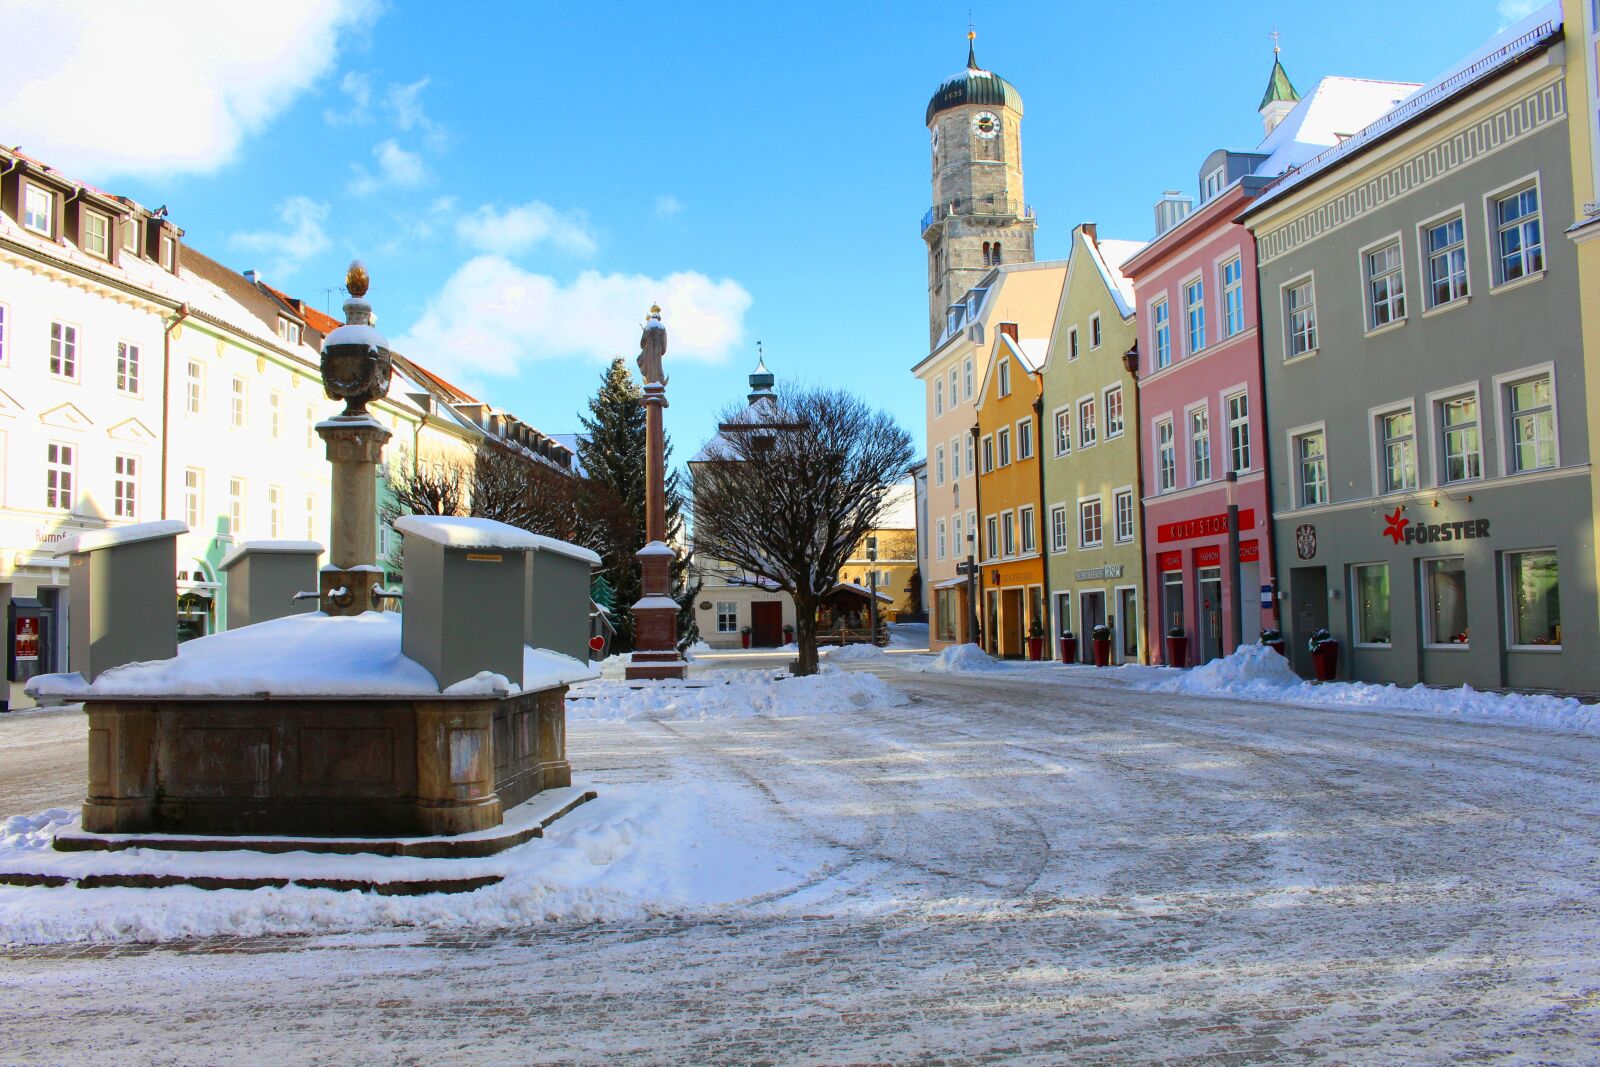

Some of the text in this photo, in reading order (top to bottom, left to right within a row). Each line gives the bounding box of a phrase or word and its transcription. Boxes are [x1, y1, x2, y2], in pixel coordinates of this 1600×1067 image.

[1170, 516, 1228, 538] KULT STOR
[1404, 518, 1491, 545] FÖRSTER
[1200, 551, 1219, 561] FASHION
[1239, 545, 1258, 557] CONCEP
